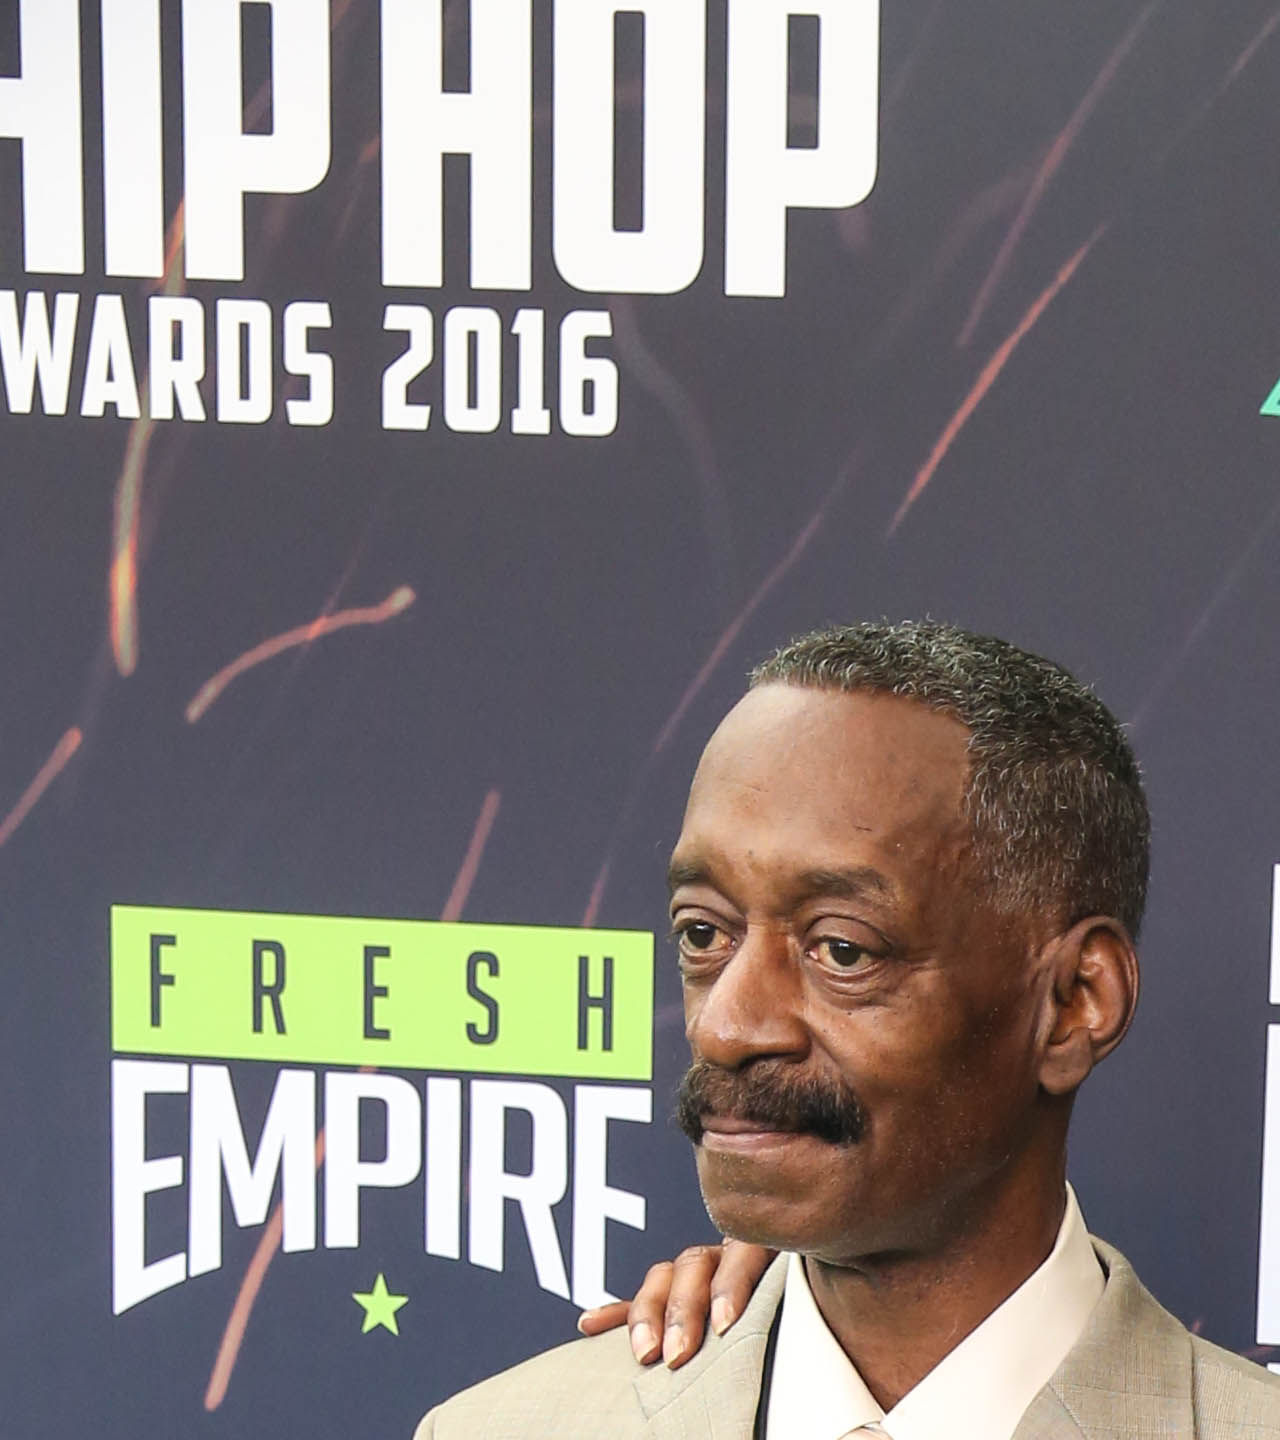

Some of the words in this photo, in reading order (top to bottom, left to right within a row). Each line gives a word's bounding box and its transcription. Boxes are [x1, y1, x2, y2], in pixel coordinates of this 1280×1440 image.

[0, 0, 331, 281] HIP
[381, 0, 880, 298] HOP
[382, 304, 619, 437] 2016
[149, 933, 615, 1053] FRESH
[110, 1059, 653, 1316] EMPIRE
